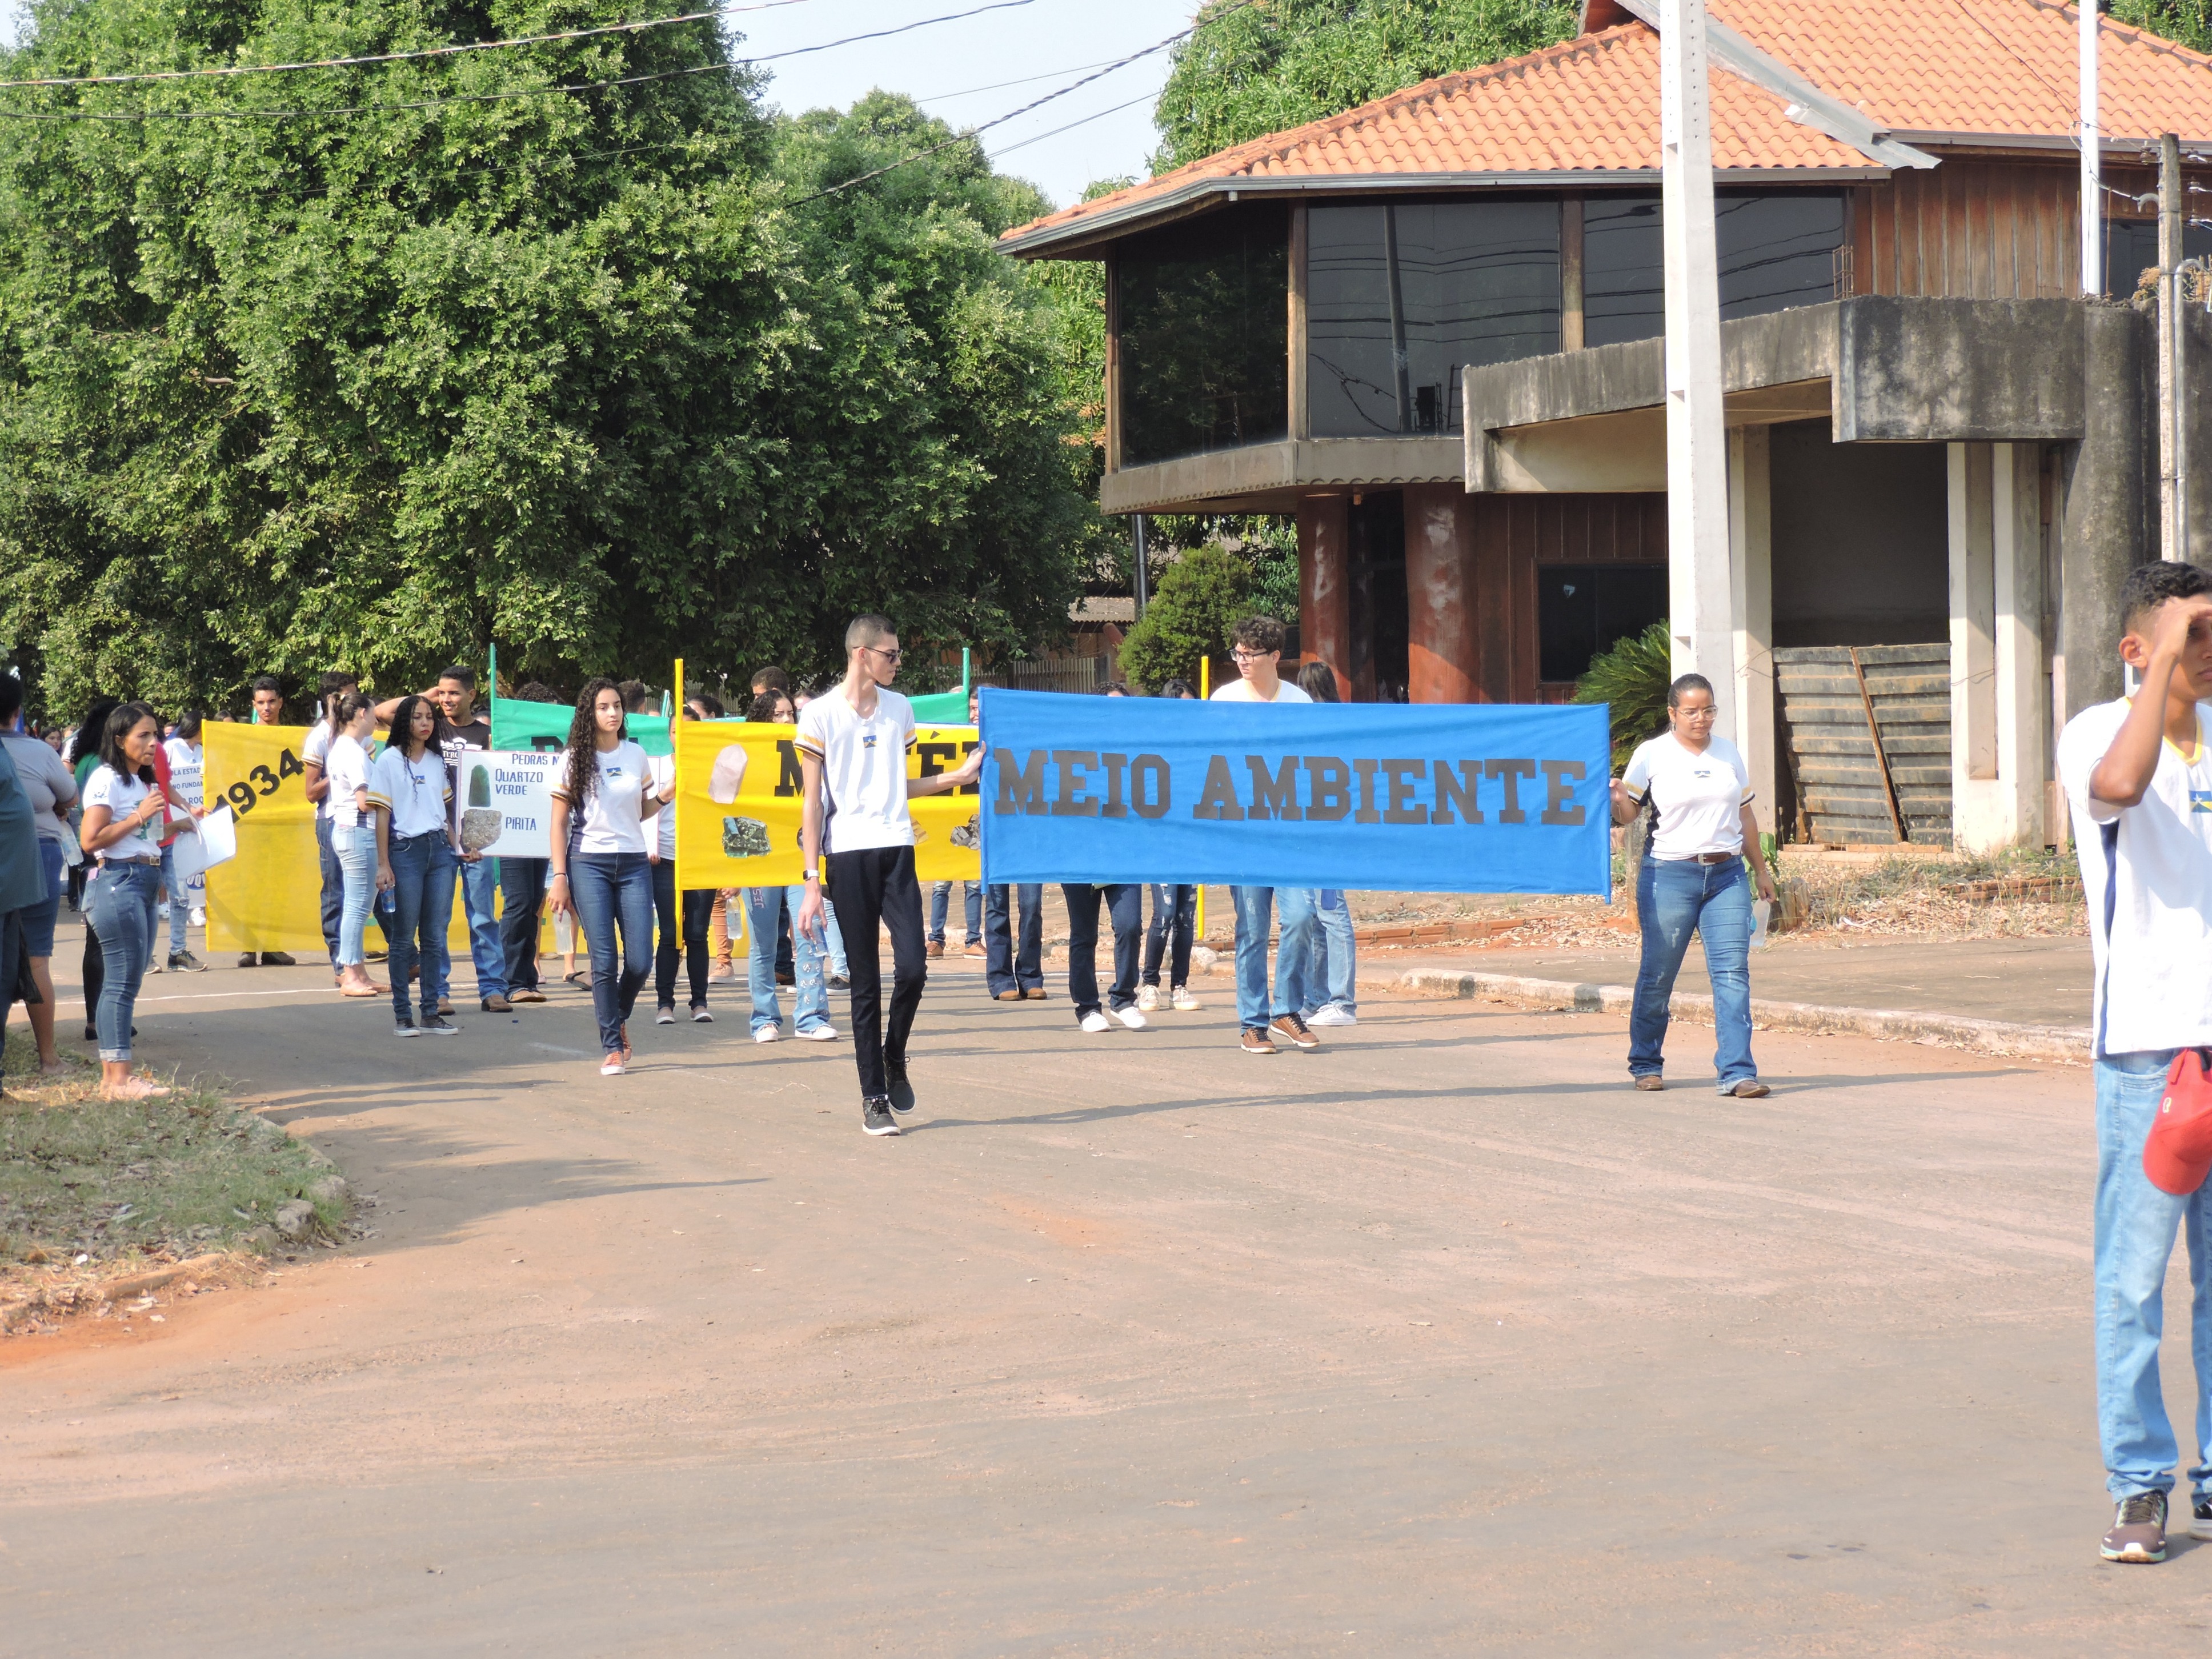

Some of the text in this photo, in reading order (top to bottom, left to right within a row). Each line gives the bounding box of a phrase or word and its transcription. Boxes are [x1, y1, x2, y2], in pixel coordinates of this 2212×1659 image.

[512, 754, 548, 765] PEDRAS
[495, 768, 543, 783] QUARTZO
[212, 747, 305, 824] 1934
[495, 784, 527, 795] VERDE
[993, 748, 1585, 826] MEIO AMBIENTE
